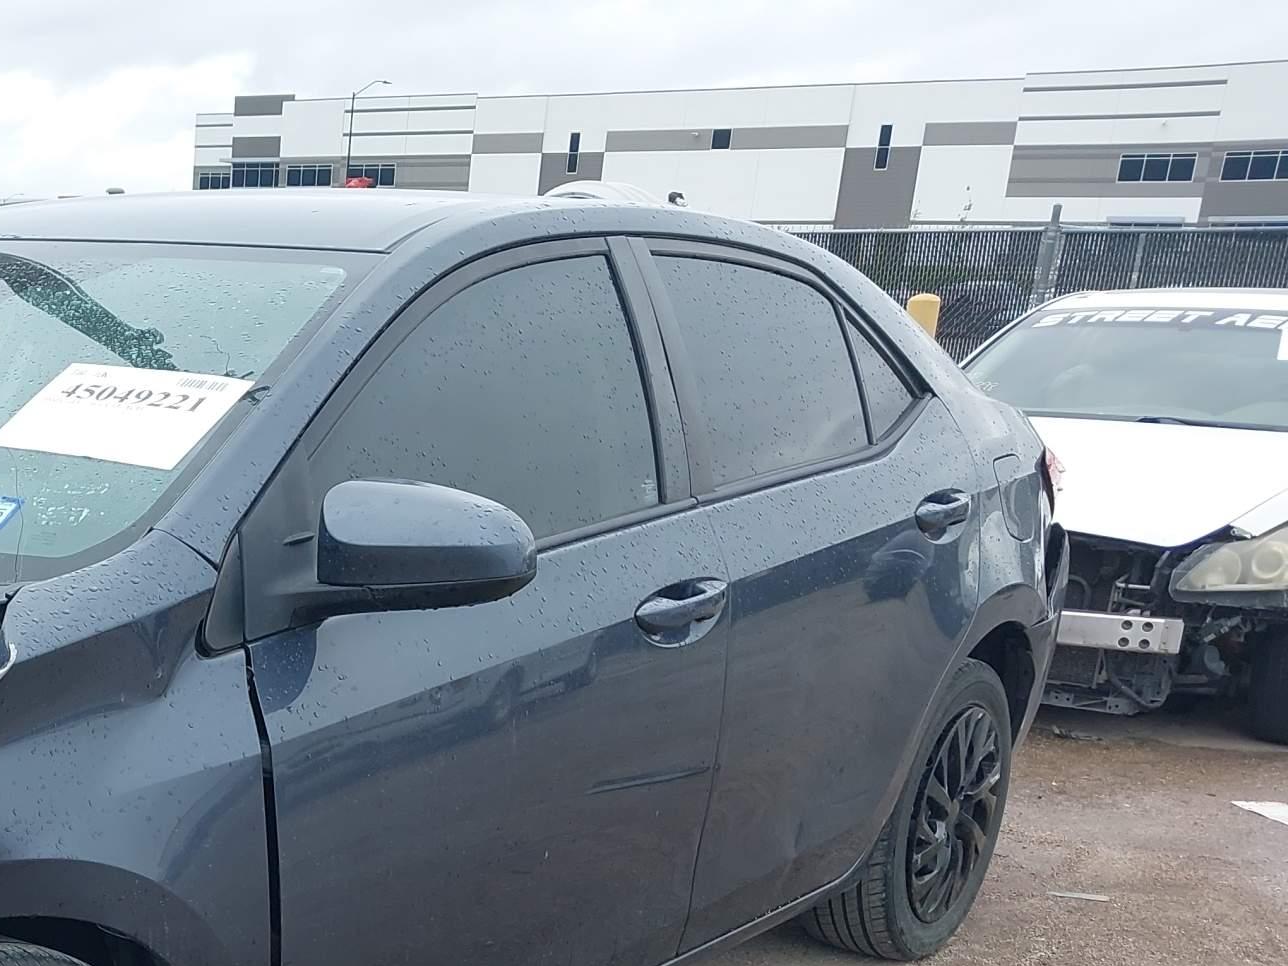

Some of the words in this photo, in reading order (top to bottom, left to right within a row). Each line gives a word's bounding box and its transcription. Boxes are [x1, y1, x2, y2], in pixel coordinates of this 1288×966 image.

[1031, 309, 1216, 328] STREET
[1216, 312, 1288, 330] AE
[61, 383, 207, 412] 45049221
